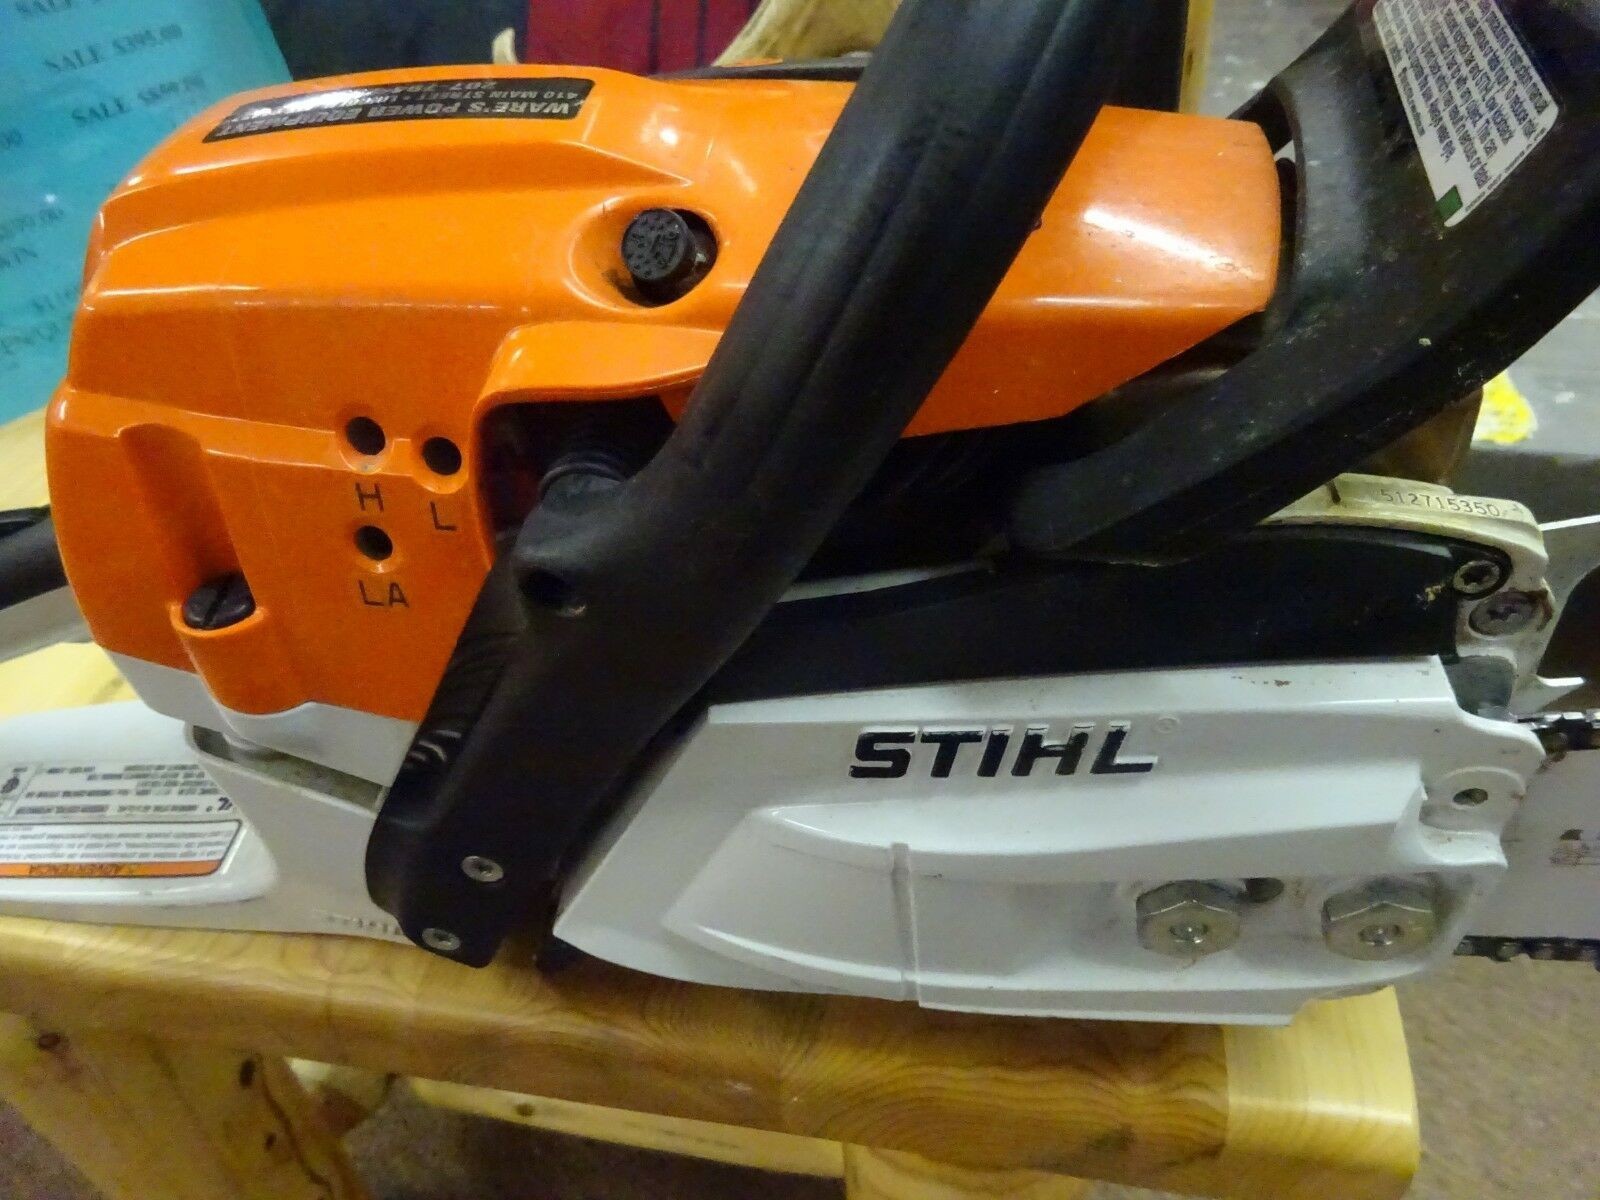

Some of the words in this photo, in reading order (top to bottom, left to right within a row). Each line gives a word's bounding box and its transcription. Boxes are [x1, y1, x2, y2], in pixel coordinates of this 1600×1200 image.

[44, 45, 104, 72] SALE
[416, 90, 487, 101] STREET
[465, 101, 575, 114] WARE'S
[487, 90, 540, 99] MAIN
[541, 91, 582, 100] 410
[1474, 71, 1494, 101] STIHL
[1490, 104, 1516, 145] kickback
[1507, 91, 1532, 126] reduce
[71, 97, 130, 127] SALE
[365, 102, 464, 117] POWER
[1426, 98, 1443, 129] Always
[1447, 102, 1463, 129] result
[1457, 128, 1478, 163] serious
[355, 483, 384, 512] H
[1381, 489, 1500, 517] 512715350
[430, 501, 457, 531] L
[358, 580, 409, 608] LA
[849, 720, 1158, 778] STIHL
